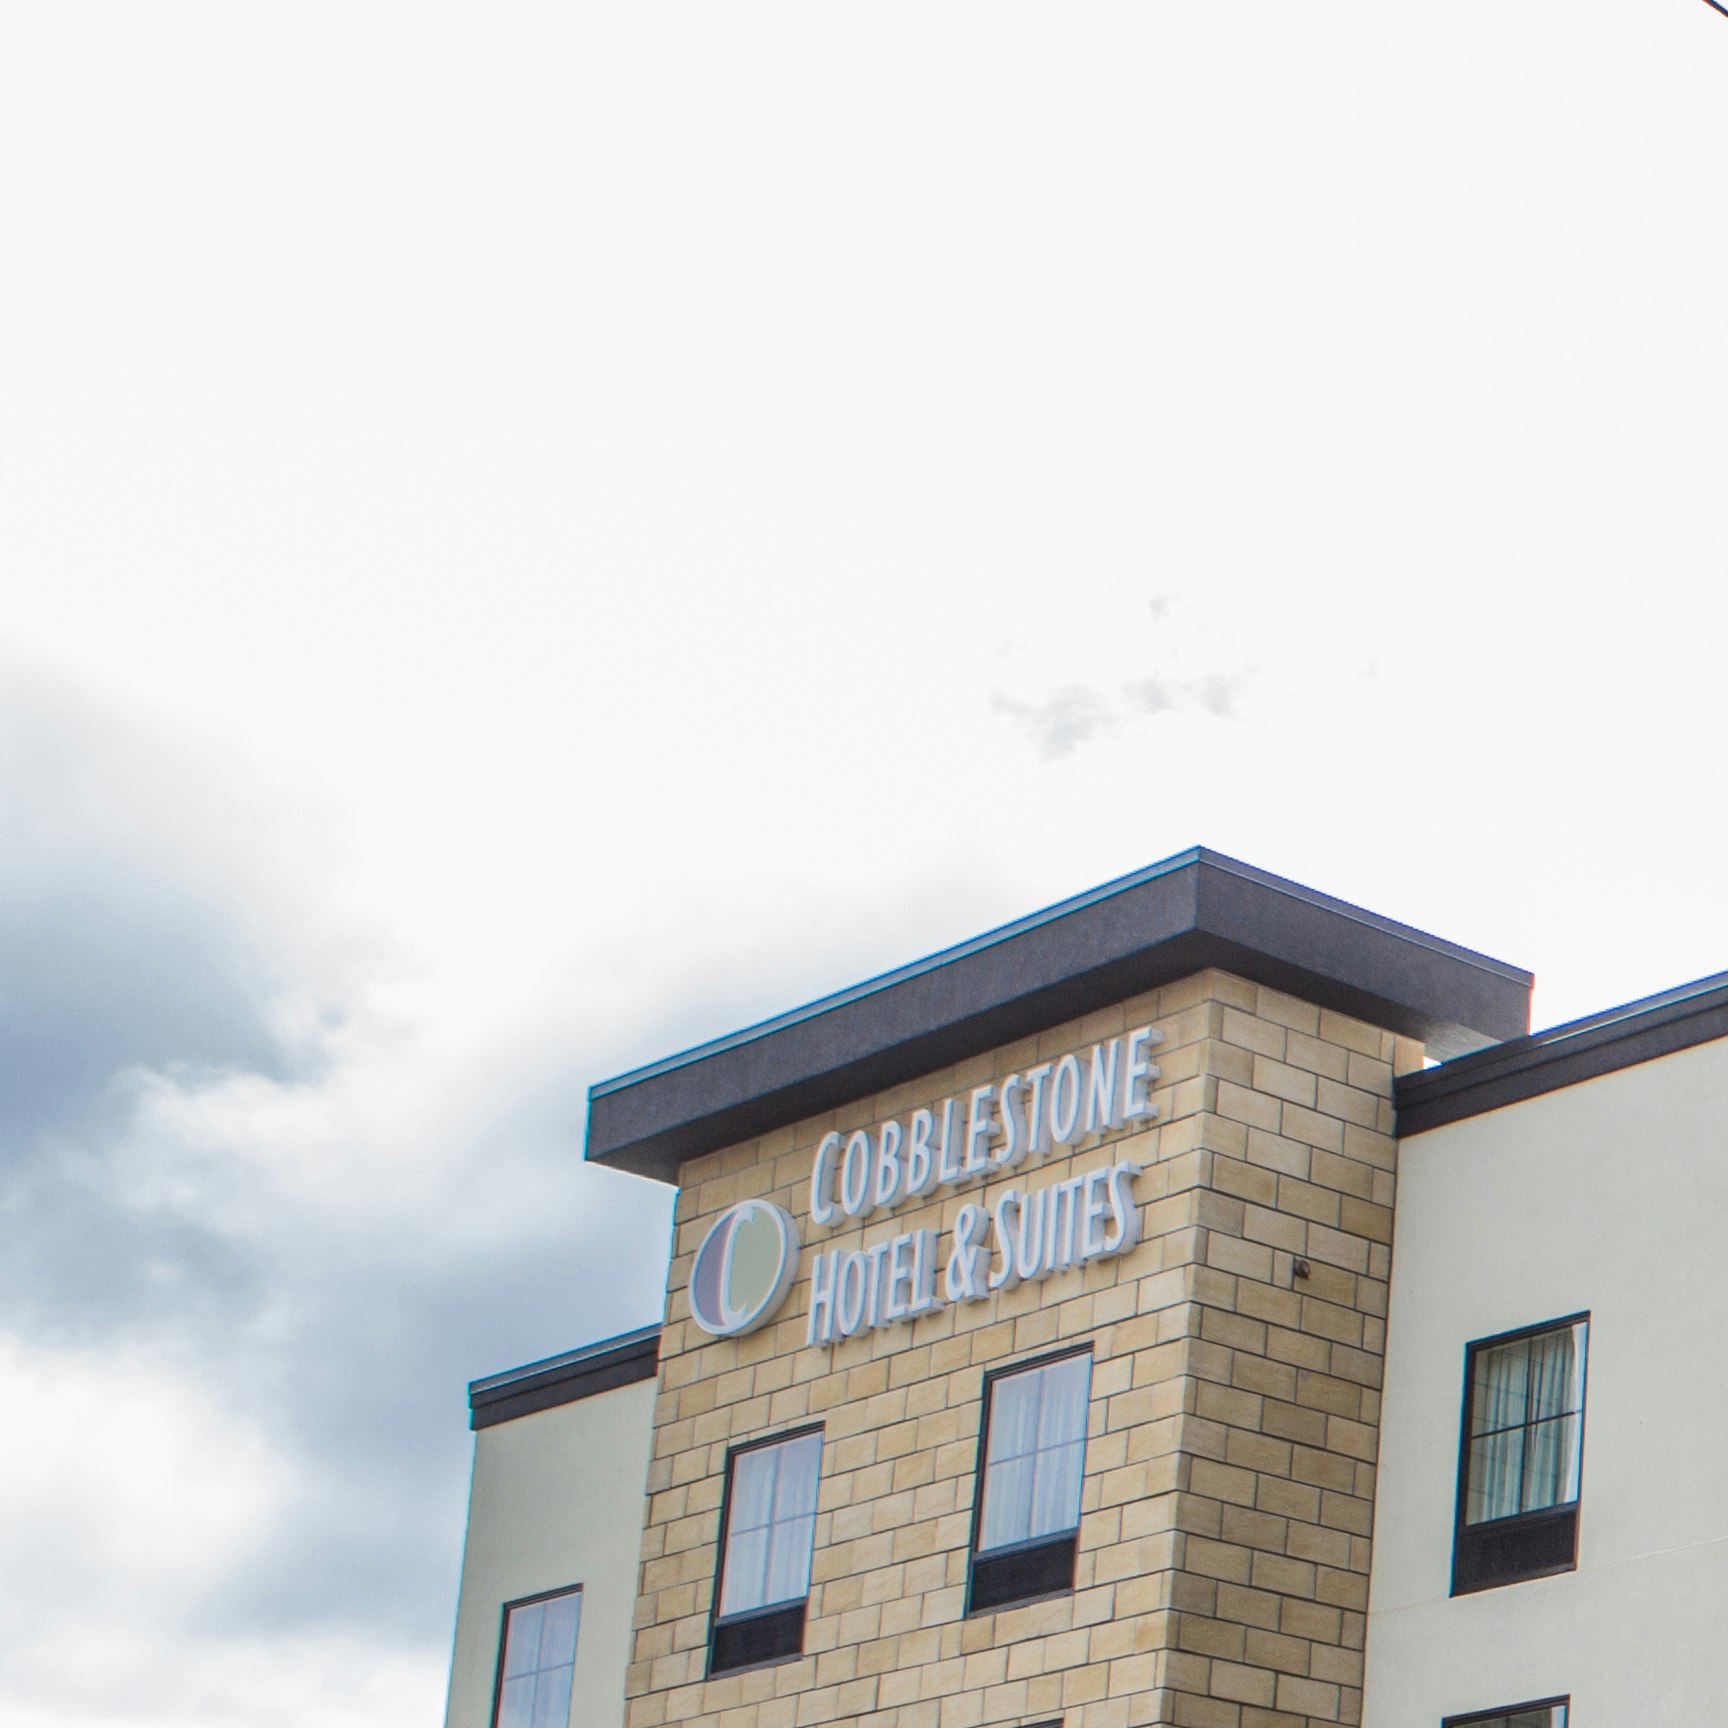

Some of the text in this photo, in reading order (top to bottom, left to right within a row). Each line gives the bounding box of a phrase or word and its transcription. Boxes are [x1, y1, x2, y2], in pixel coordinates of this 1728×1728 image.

[811, 1026, 1164, 1228] COBBLESTONE
[806, 1160, 1142, 1348] HOTEL & SUITES
